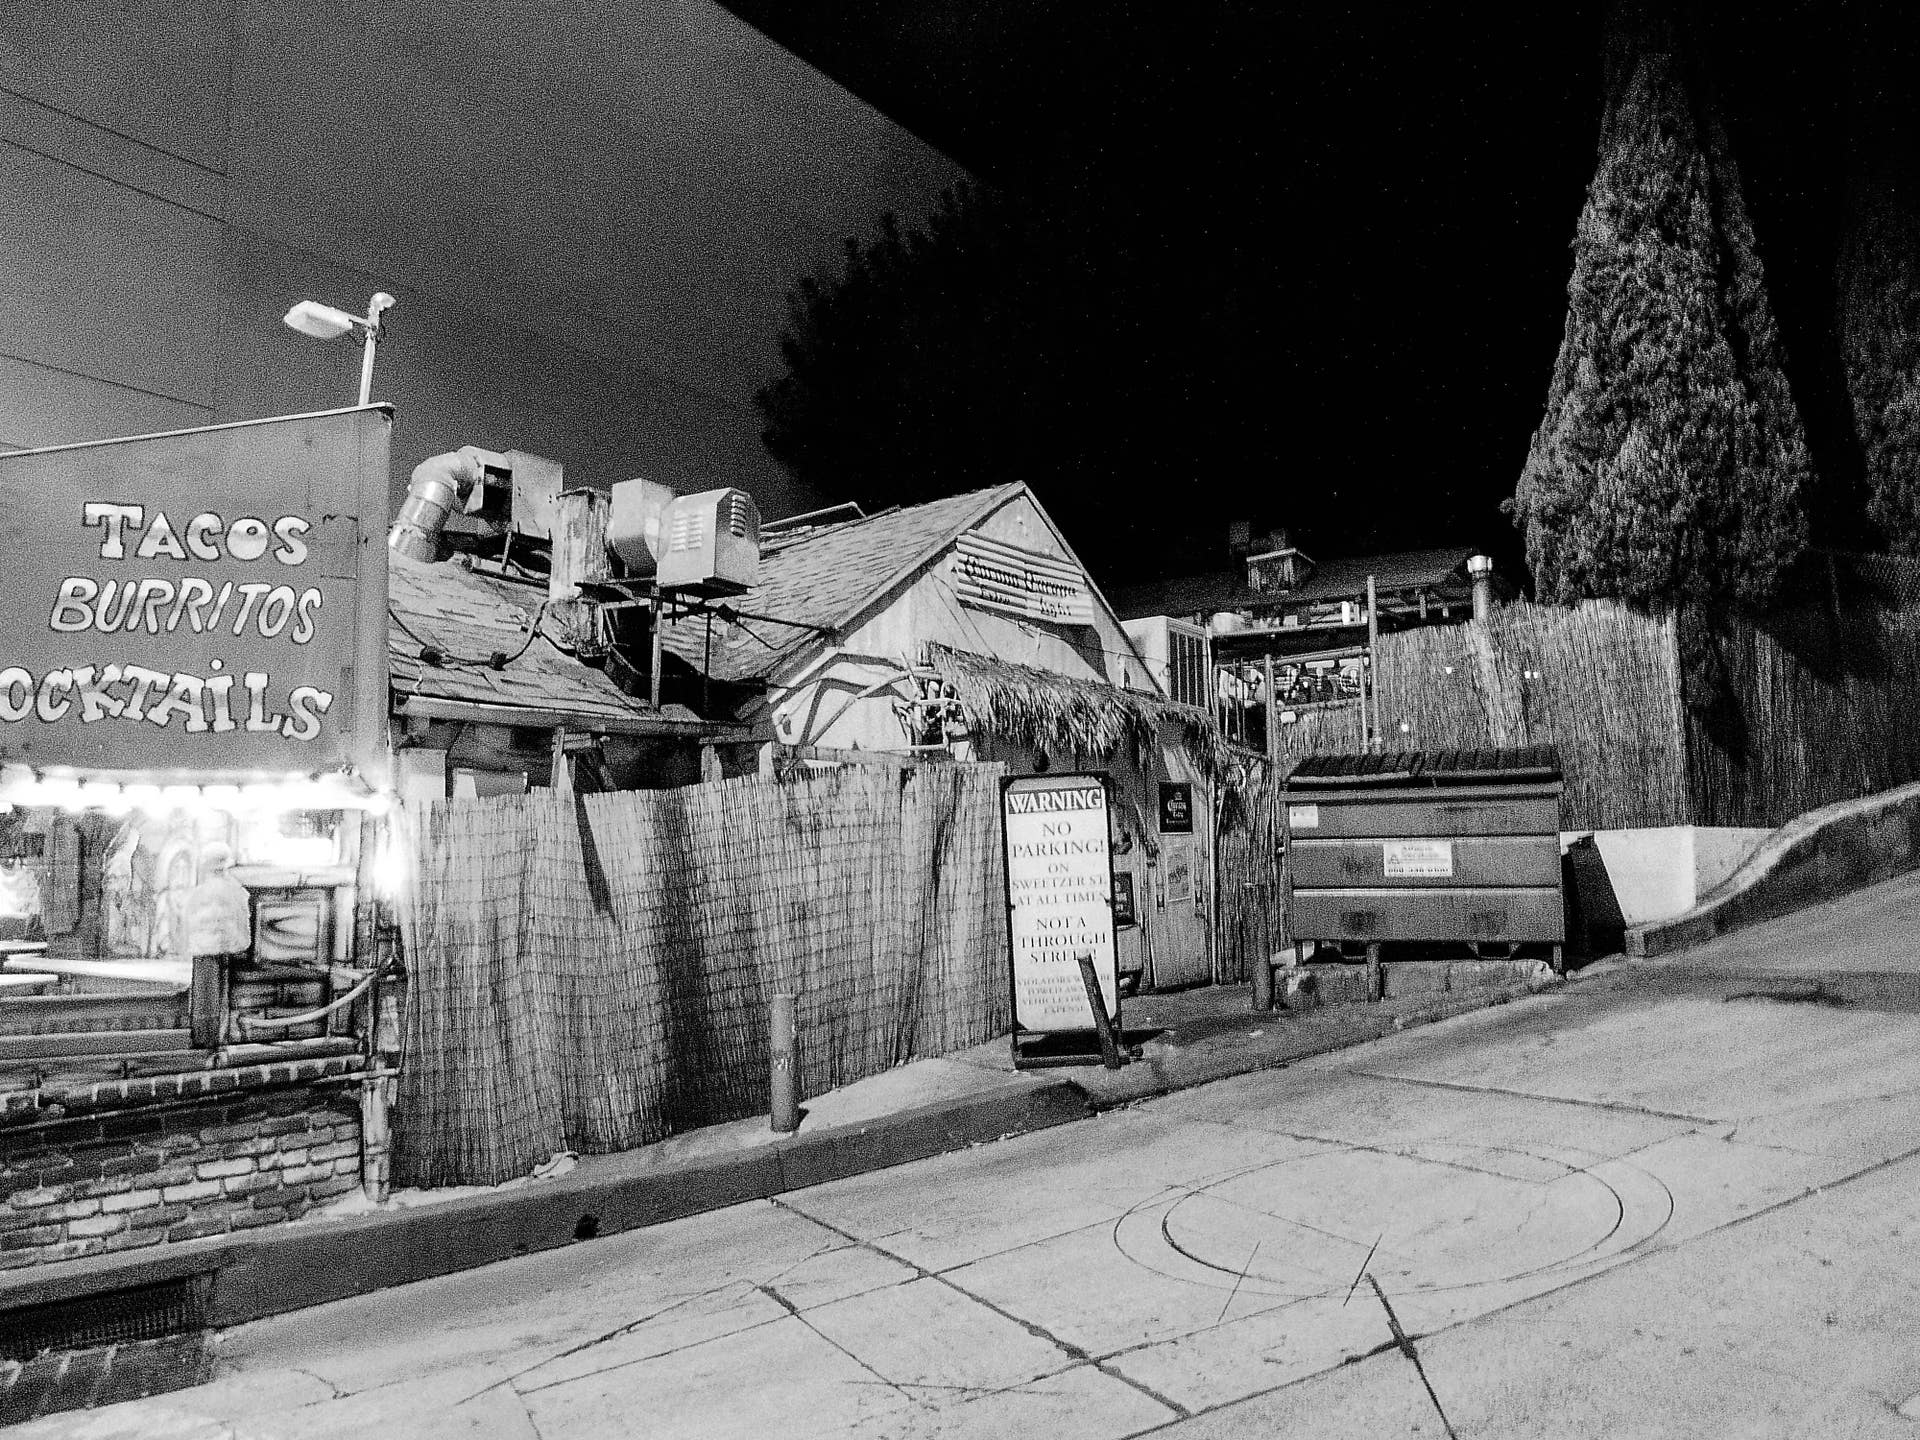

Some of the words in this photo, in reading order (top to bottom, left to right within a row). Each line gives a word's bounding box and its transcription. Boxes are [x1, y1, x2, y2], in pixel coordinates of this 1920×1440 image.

[82, 501, 311, 566] TACOS
[50, 577, 323, 644] BURRITOS
[1008, 788, 1102, 814] WARNING
[1043, 821, 1071, 837] NO
[1012, 839, 1104, 858] PARKING!
[1048, 863, 1070, 873] ON
[1018, 894, 1032, 906] AT
[1038, 893, 1059, 905] ALL
[1036, 916, 1074, 930] NOT
[1077, 916, 1087, 928] A
[1021, 931, 1107, 949] THROUGH
[1030, 948, 1097, 963] STREE!
